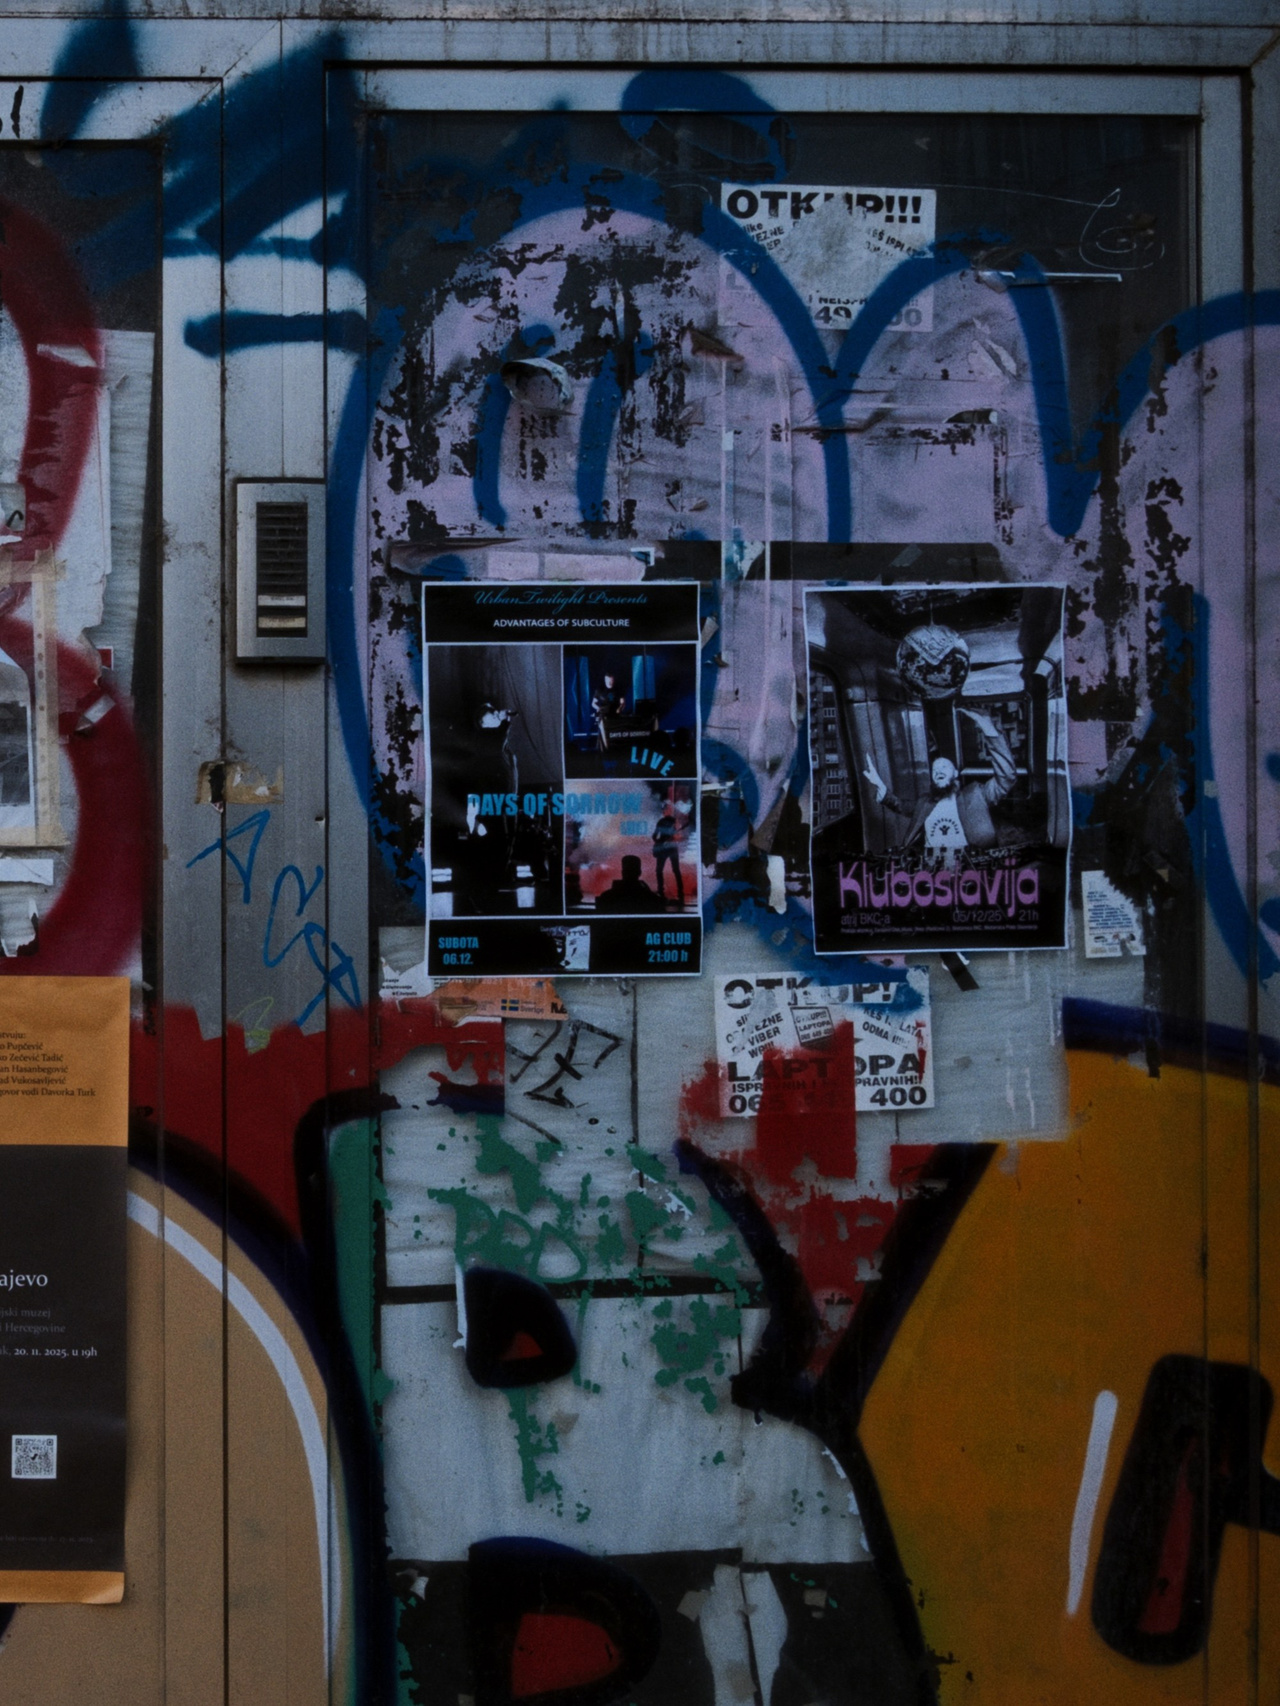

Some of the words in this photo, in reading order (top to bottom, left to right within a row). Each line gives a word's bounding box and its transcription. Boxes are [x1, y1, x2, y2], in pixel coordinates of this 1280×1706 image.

[473, 586, 521, 605] Urban
[520, 586, 586, 615] Twilight
[586, 588, 649, 605] Presents
[493, 618, 555, 628] ADVANTAGES
[557, 618, 570, 628] OF
[571, 618, 630, 628] SUBCULTURE
[630, 745, 675, 777] LIVE
[467, 793, 519, 816] DAYS
[523, 793, 548, 816] OF
[551, 793, 643, 816] SORROW
[838, 857, 1040, 918] Kluboslavija
[952, 909, 1003, 923] 05/12/25
[1018, 909, 1040, 922] 21h
[437, 936, 480, 950] SUBOTA
[645, 932, 660, 946] AG
[662, 931, 692, 946] CLUB
[442, 952, 474, 966] 06.12.
[647, 949, 679, 964] 21:00
[680, 950, 689, 963] h
[870, 1086, 927, 1107] 400
[20, 1308, 51, 1320] muzej
[5, 1322, 66, 1336] Hercegovine
[14, 1348, 29, 1357] 20.
[31, 1348, 42, 1357] 11.
[44, 1348, 70, 1359] 2025.
[71, 1349, 79, 1357] u
[81, 1346, 98, 1359] 19h
